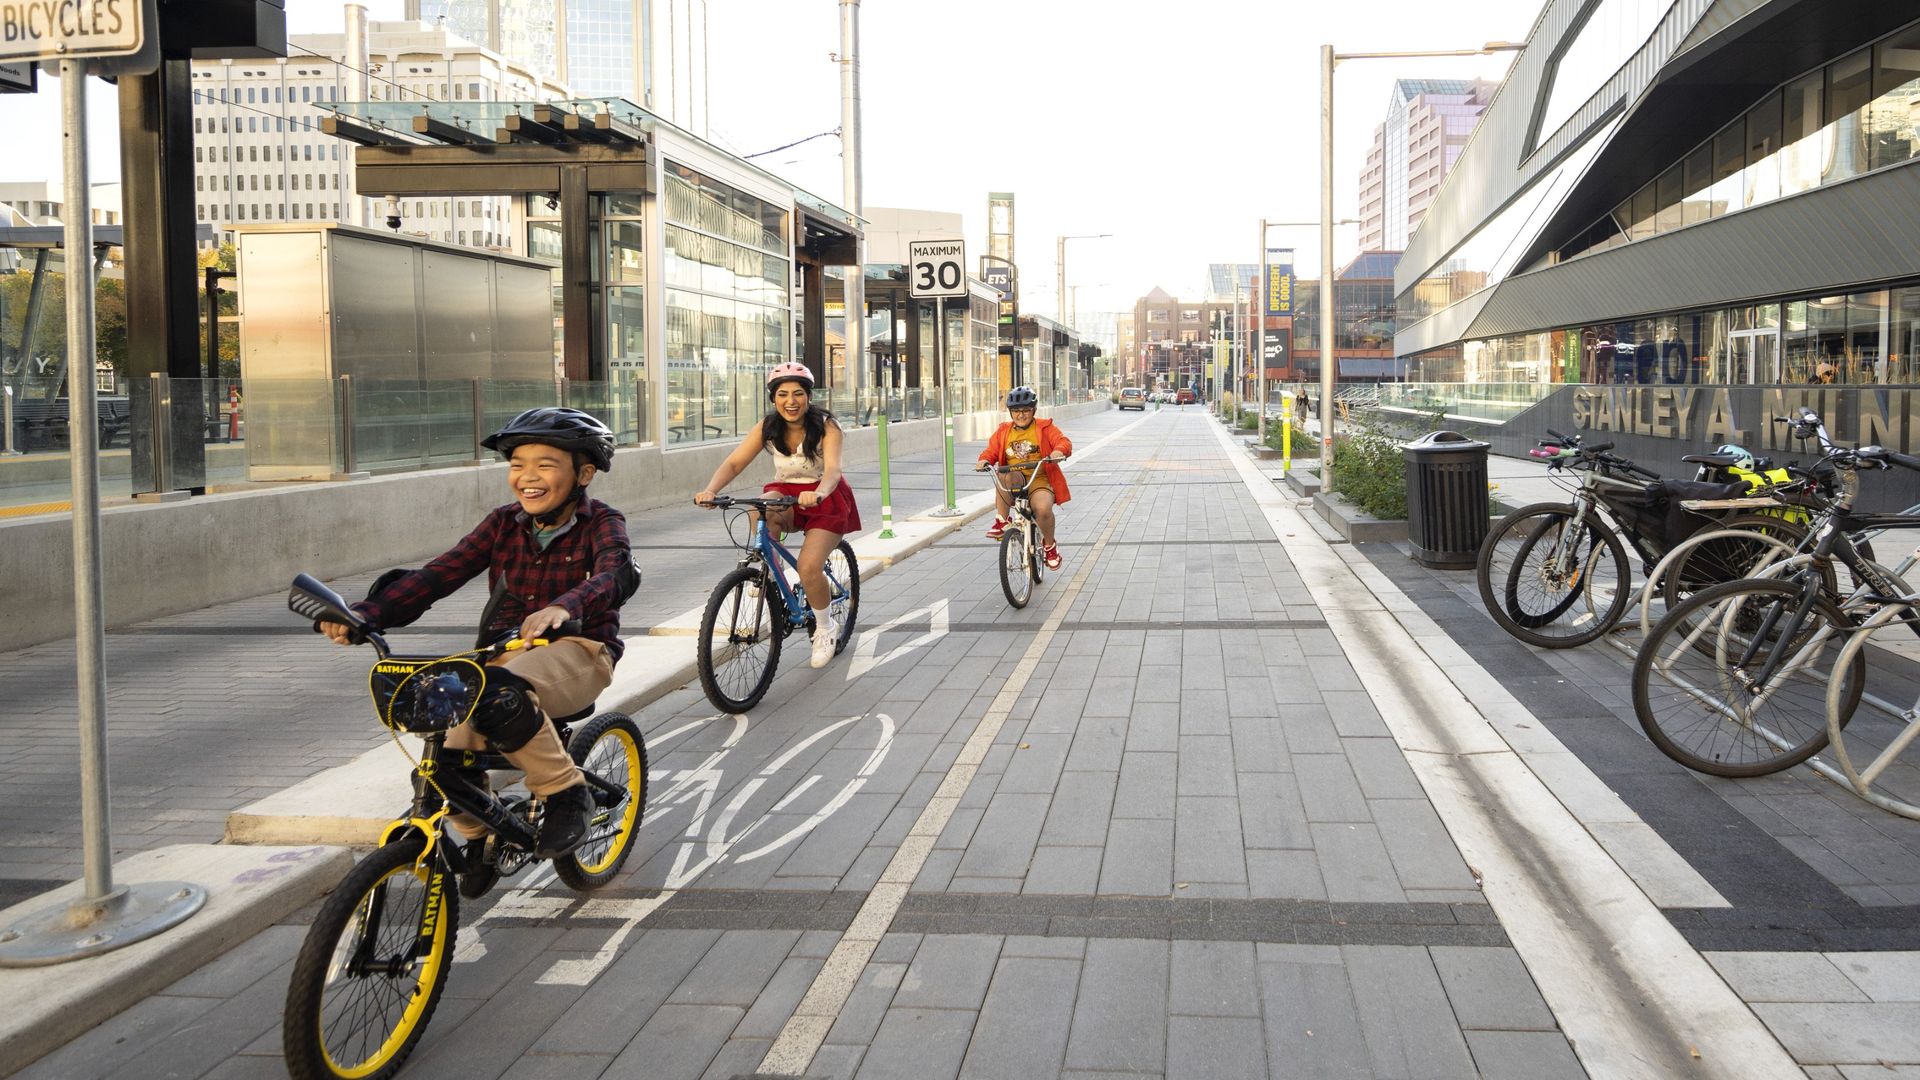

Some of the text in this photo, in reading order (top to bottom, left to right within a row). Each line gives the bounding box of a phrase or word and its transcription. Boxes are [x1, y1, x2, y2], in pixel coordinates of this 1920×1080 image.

[4, 0, 122, 41] BICYCLES
[914, 246, 961, 256] MAXIMUM
[916, 261, 961, 290] 30
[988, 274, 1007, 284] ETS
[1573, 386, 1697, 440] STANLEY
[1855, 559, 1899, 599] TRE
[377, 665, 414, 673] BATMAN
[422, 873, 443, 936] BATMAN
